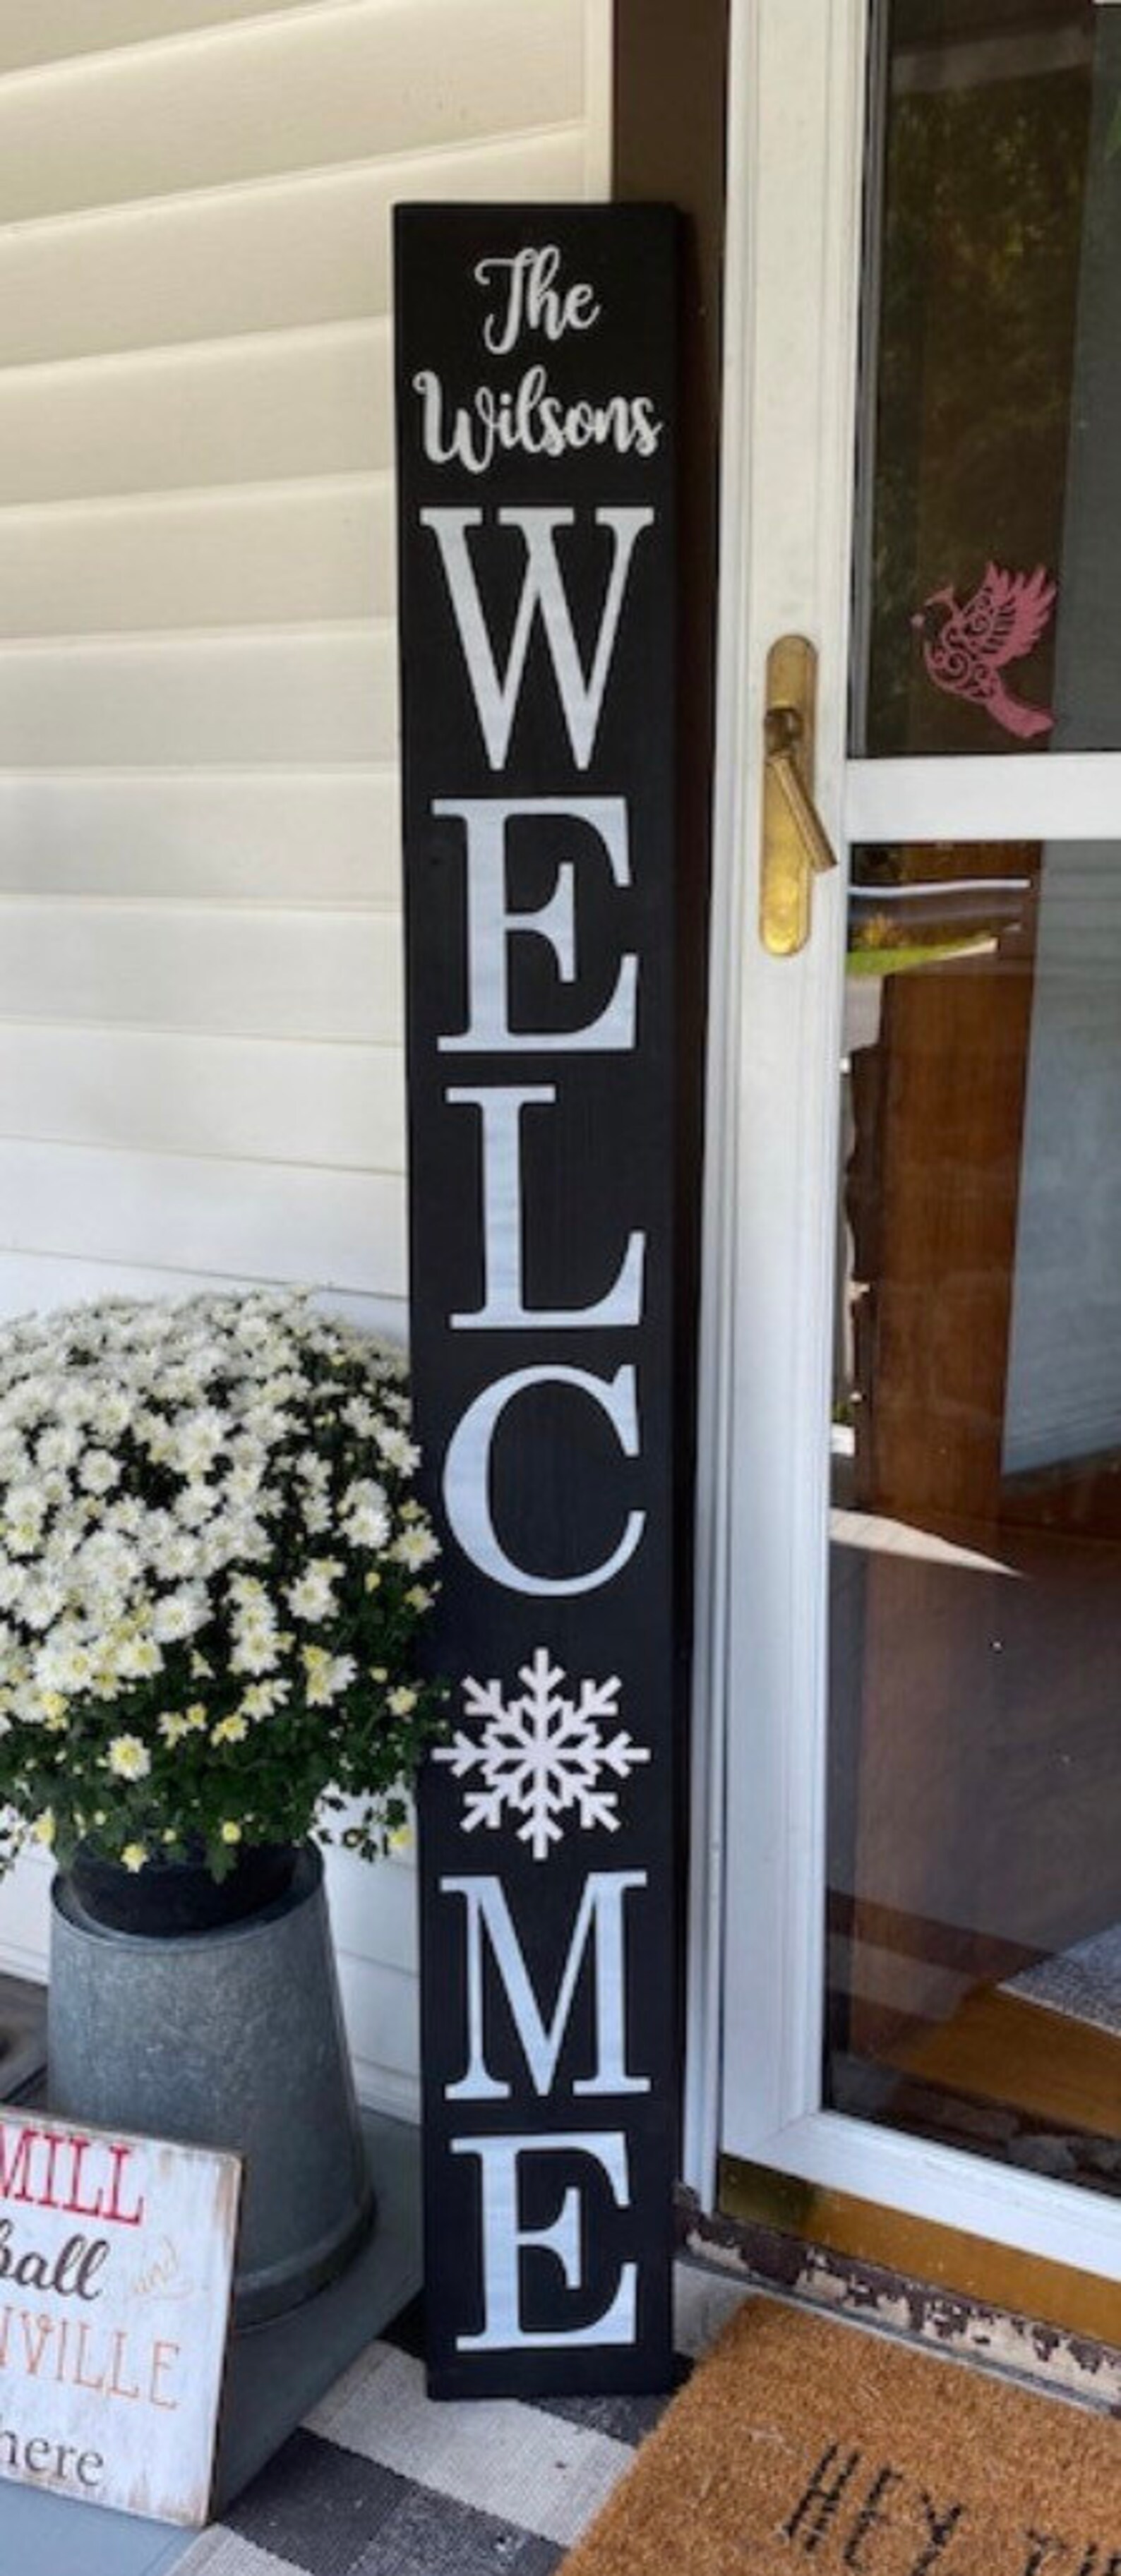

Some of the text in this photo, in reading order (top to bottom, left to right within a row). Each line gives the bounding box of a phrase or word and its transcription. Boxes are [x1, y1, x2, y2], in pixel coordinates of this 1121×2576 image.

[475, 246, 600, 354] The
[414, 365, 662, 474] Wilsons
[421, 508, 653, 2350] WELCME
[0, 2306, 181, 2409] VILLE
[781, 2443, 962, 2576] HEY
